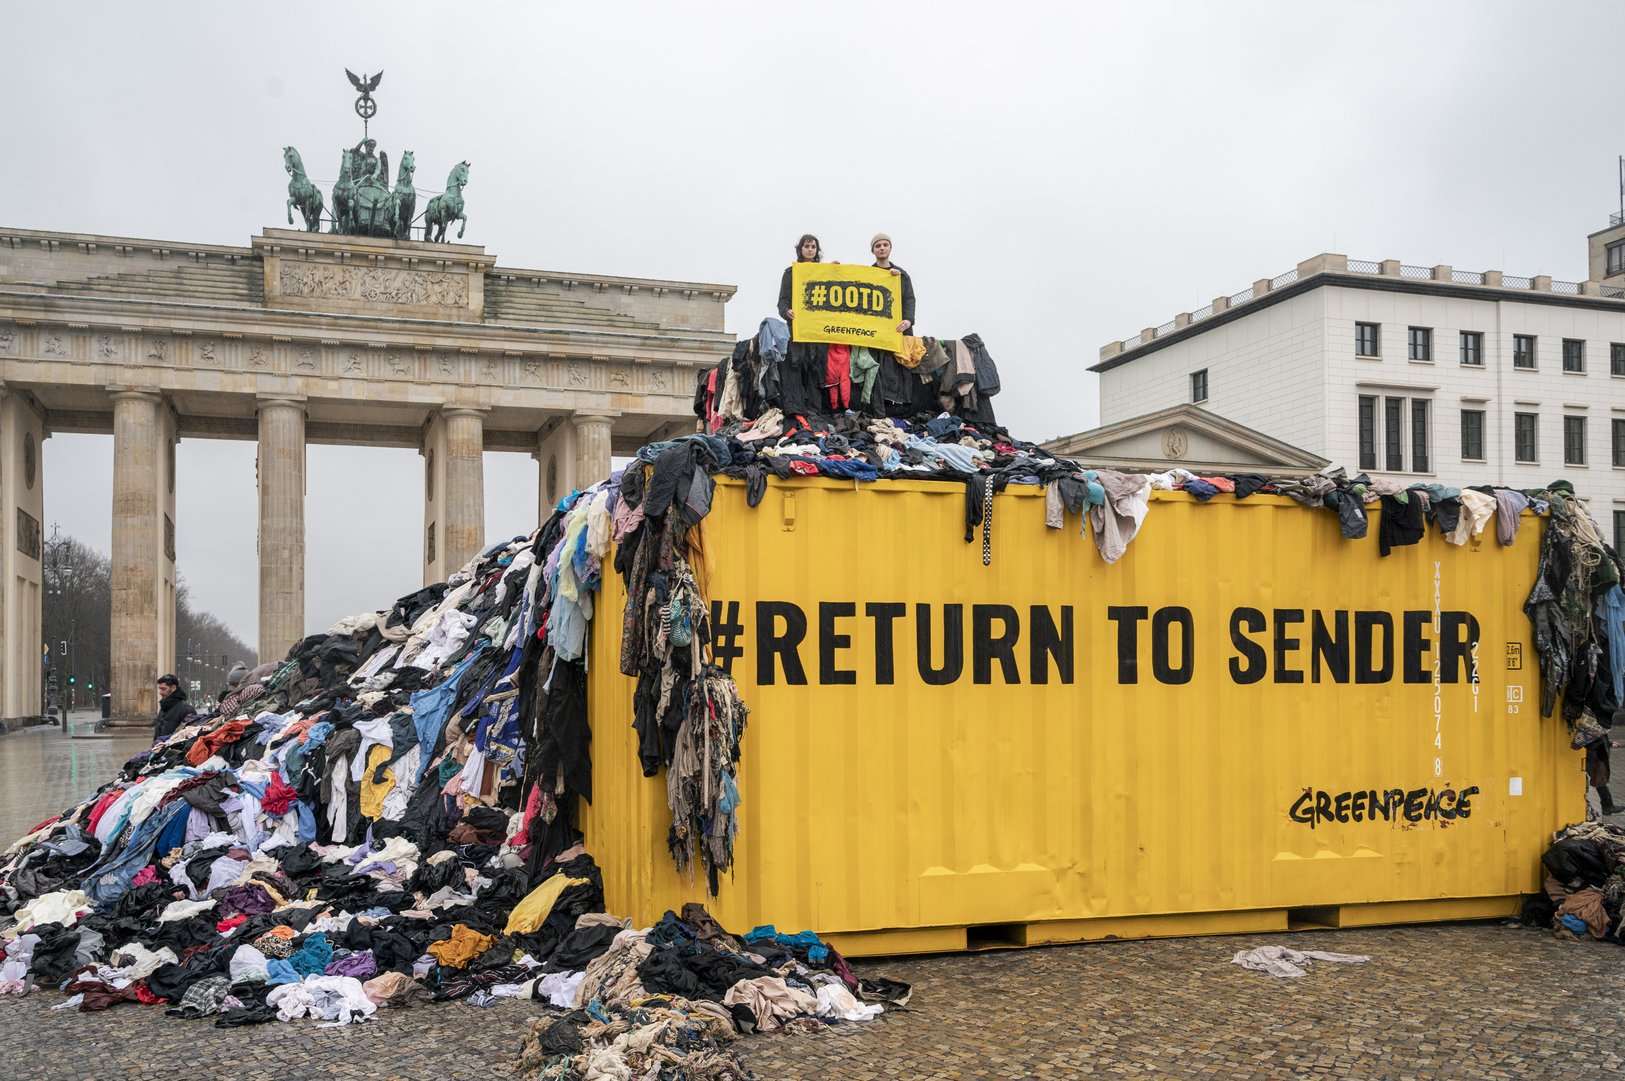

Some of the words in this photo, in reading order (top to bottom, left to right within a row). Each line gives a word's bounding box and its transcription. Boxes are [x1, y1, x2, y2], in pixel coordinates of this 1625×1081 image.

[811, 285, 884, 312] #OOTD
[823, 325, 877, 338] GREENPEACE
[710, 600, 1075, 686] #RETURN
[1108, 606, 1195, 685] TO
[1229, 606, 1481, 685] SENDER
[1471, 641, 1480, 713] 22G1
[1508, 705, 1519, 714] 83
[1434, 758, 1441, 776] 8
[1289, 786, 1480, 829] GREENPEACE
